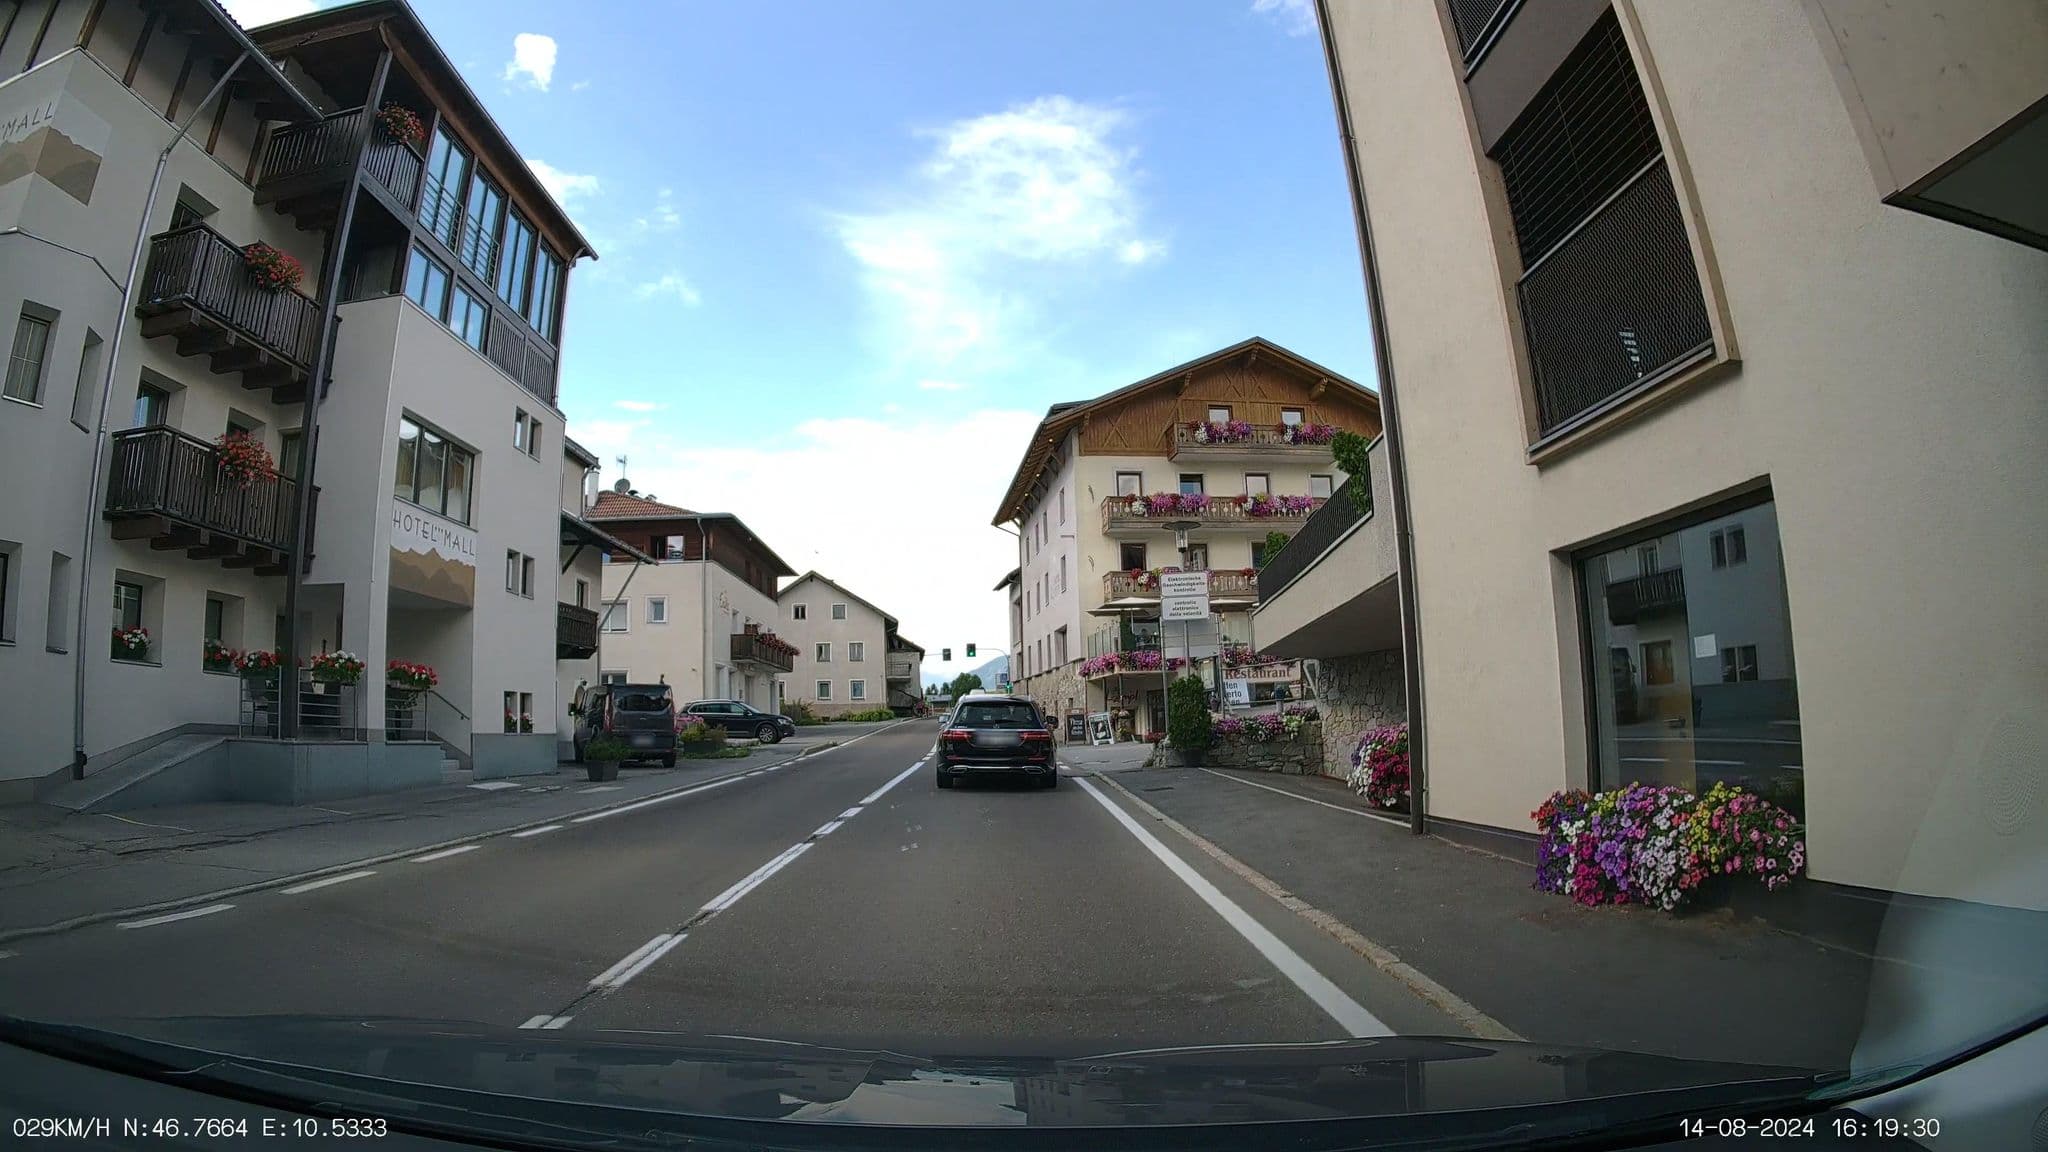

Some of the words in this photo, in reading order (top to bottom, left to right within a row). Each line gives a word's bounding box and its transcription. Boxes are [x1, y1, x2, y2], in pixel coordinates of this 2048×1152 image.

[3, 101, 53, 140] MALL
[393, 510, 437, 543] HOTEL
[443, 529, 475, 556] MALL
[1225, 665, 1291, 680] Restaurant
[1225, 690, 1242, 698] erto
